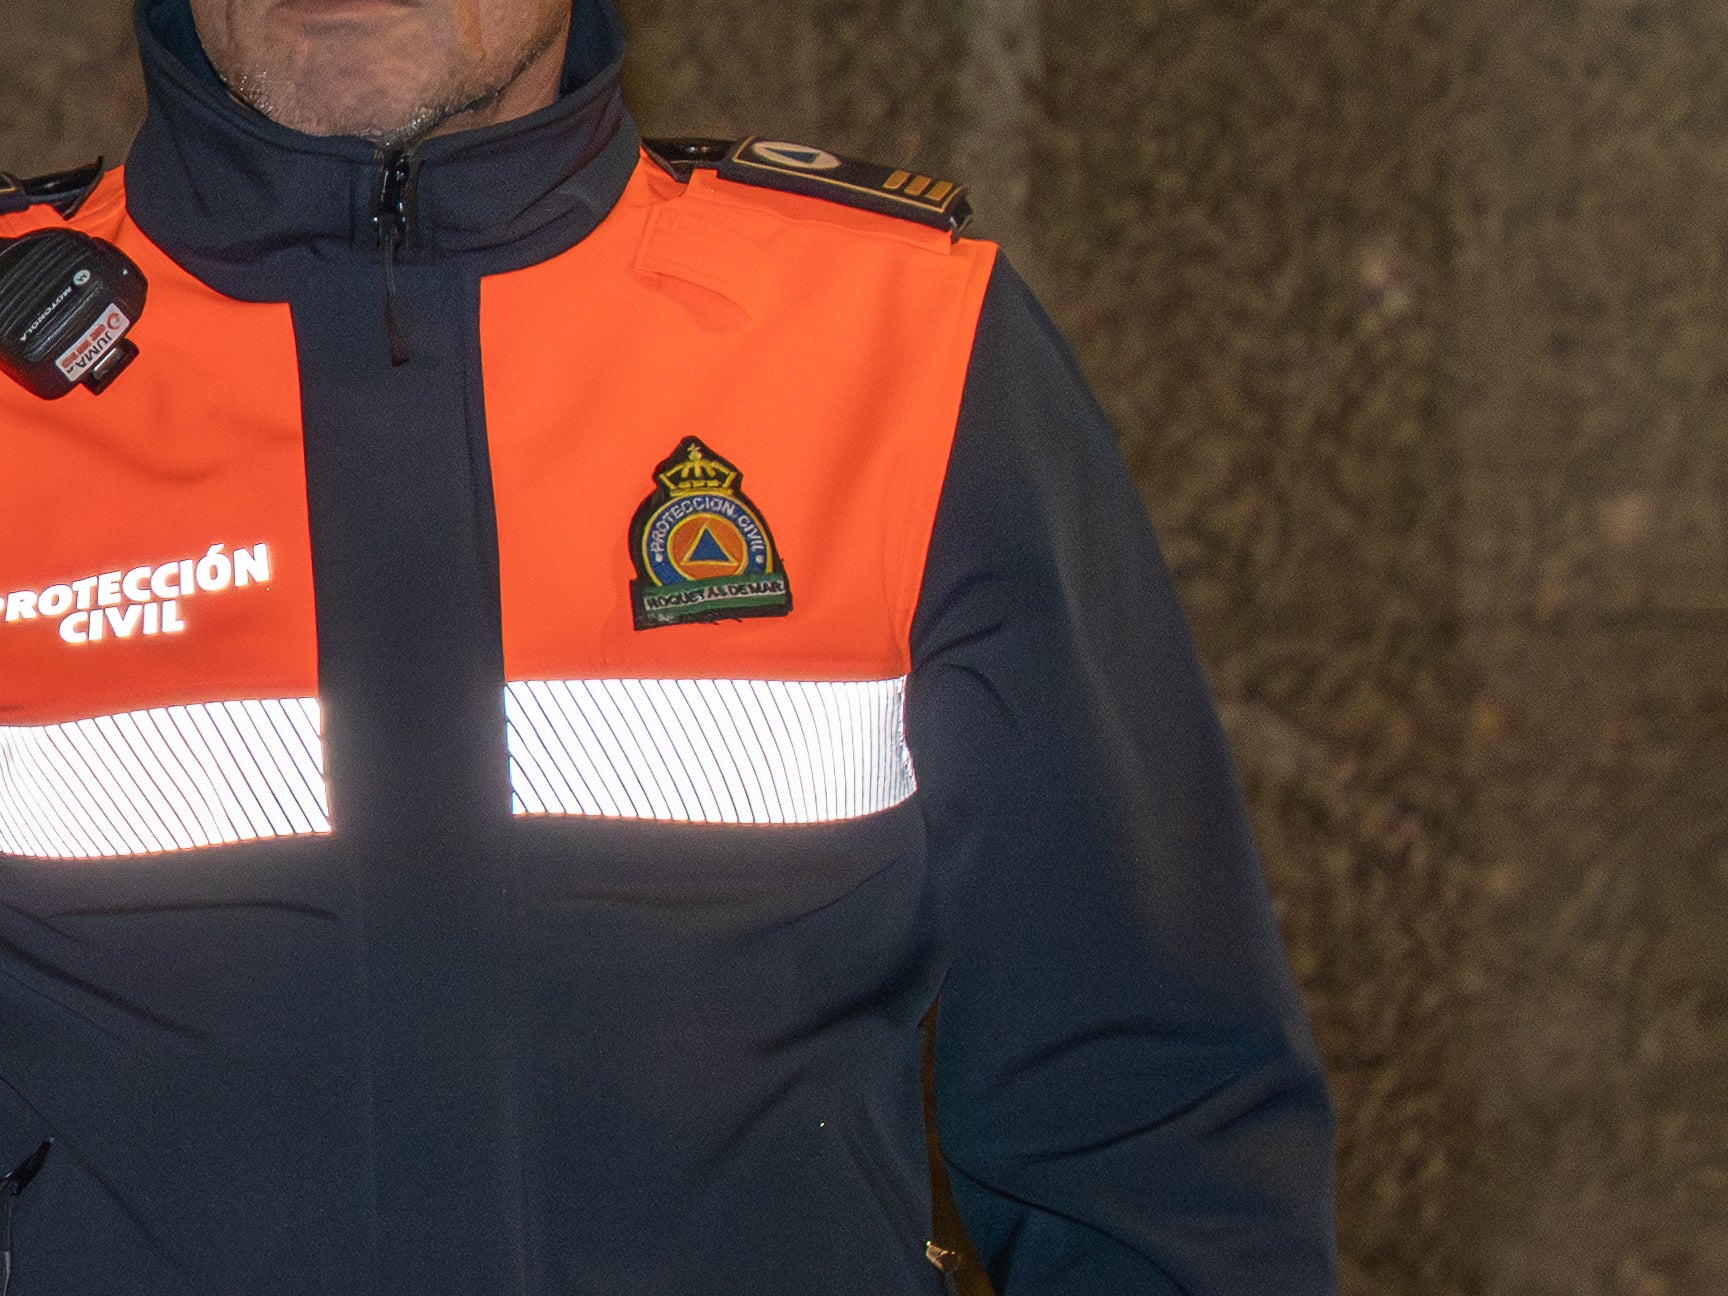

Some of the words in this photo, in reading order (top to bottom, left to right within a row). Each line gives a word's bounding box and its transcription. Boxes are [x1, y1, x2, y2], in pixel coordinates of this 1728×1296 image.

[20, 286, 72, 341] MOTOROLA
[75, 331, 113, 368] JUMA
[59, 600, 184, 643] CIVIL
